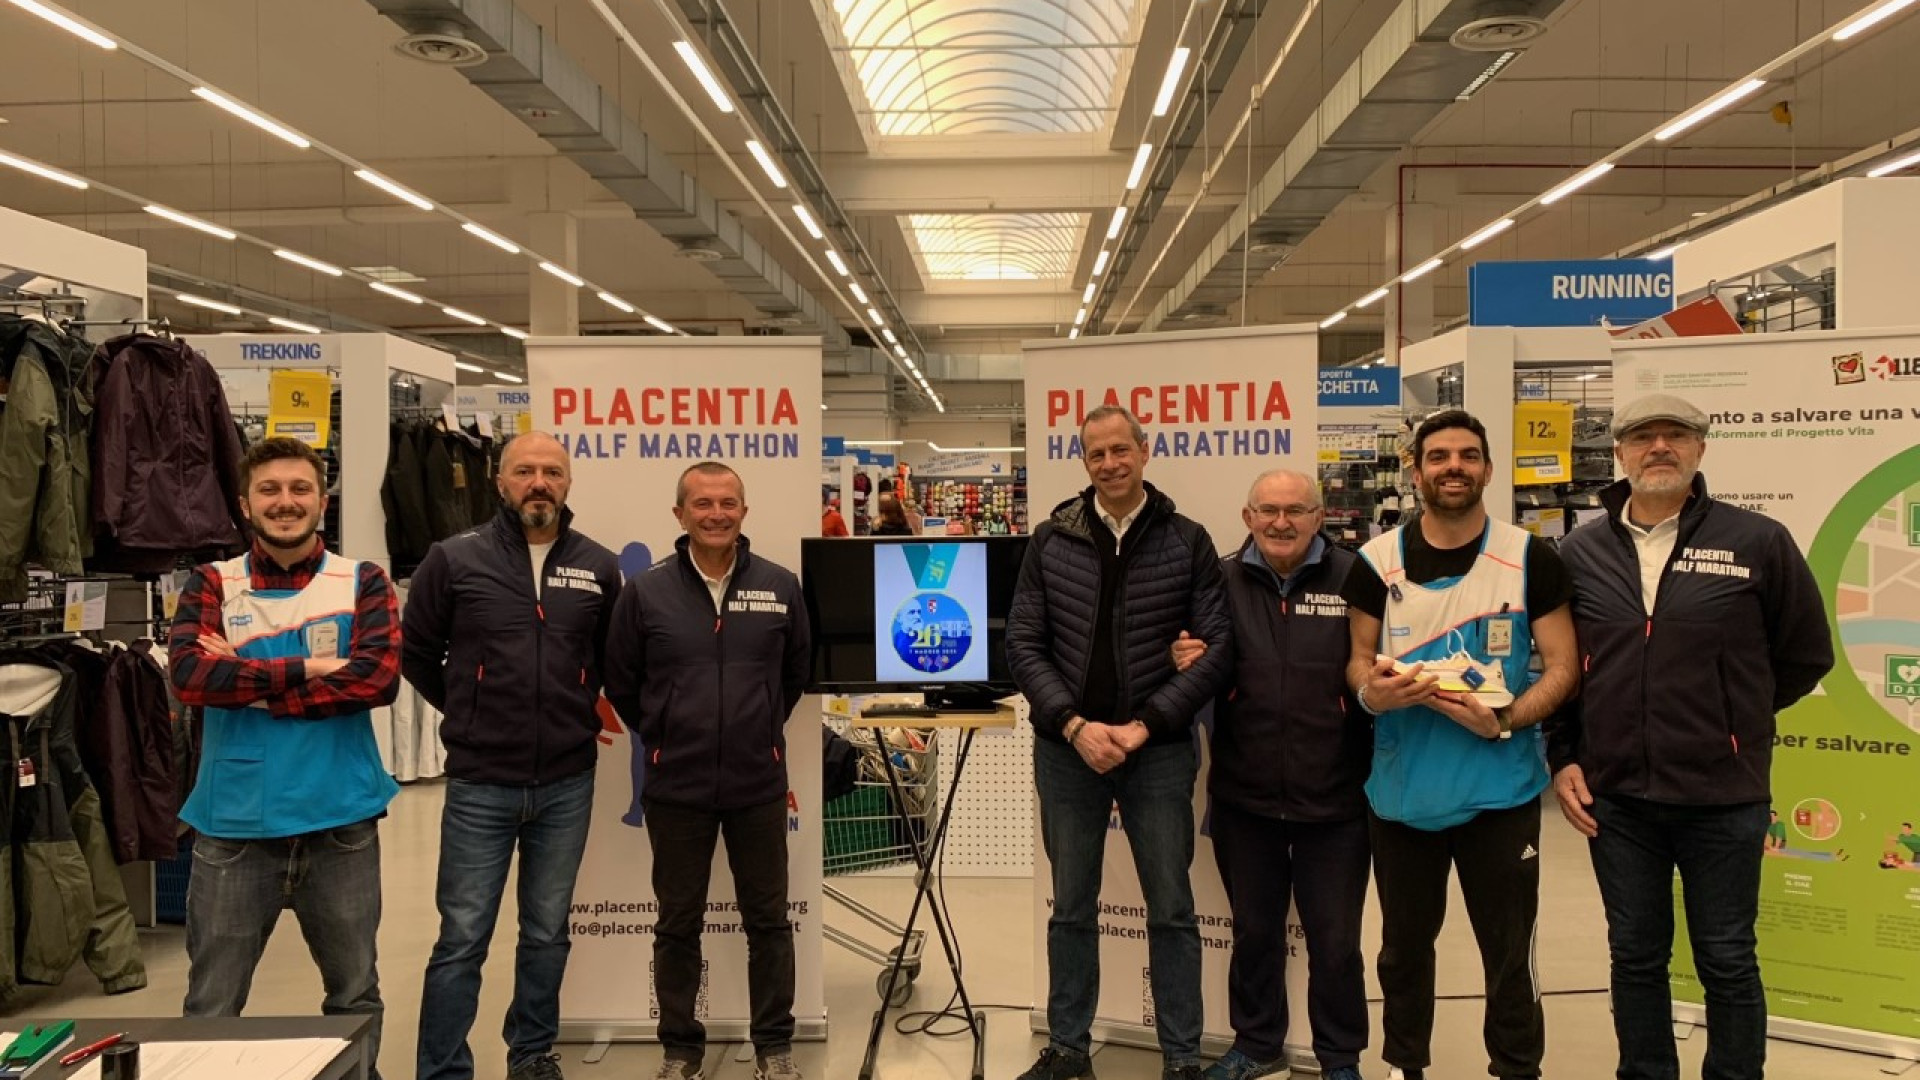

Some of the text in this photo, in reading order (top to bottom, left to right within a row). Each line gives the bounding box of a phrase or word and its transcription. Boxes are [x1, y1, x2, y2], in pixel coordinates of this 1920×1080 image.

[1552, 274, 1672, 300] RUNNING
[240, 343, 321, 361] TREKKING
[1320, 371, 1352, 379] SPORT DI
[553, 387, 799, 426] PLACENTIA
[1709, 410, 1745, 424] nto
[1752, 411, 1764, 423] a
[1771, 408, 1852, 423] salvare
[1860, 407, 1903, 420] una
[1706, 426, 1875, 439] nFormare di Progetto Vita
[640, 432, 799, 458] MARATHON
[1142, 428, 1291, 457] ARATHON
[1707, 492, 1794, 500] sono usare un
[1682, 547, 1734, 563] PLACENTIA
[1695, 561, 1750, 579] MARATHON
[547, 576, 567, 588] HALF
[737, 590, 776, 601] PLACENTIA
[728, 600, 748, 612] HALF
[1295, 603, 1316, 616] HALF
[1815, 735, 1911, 756] salvare
